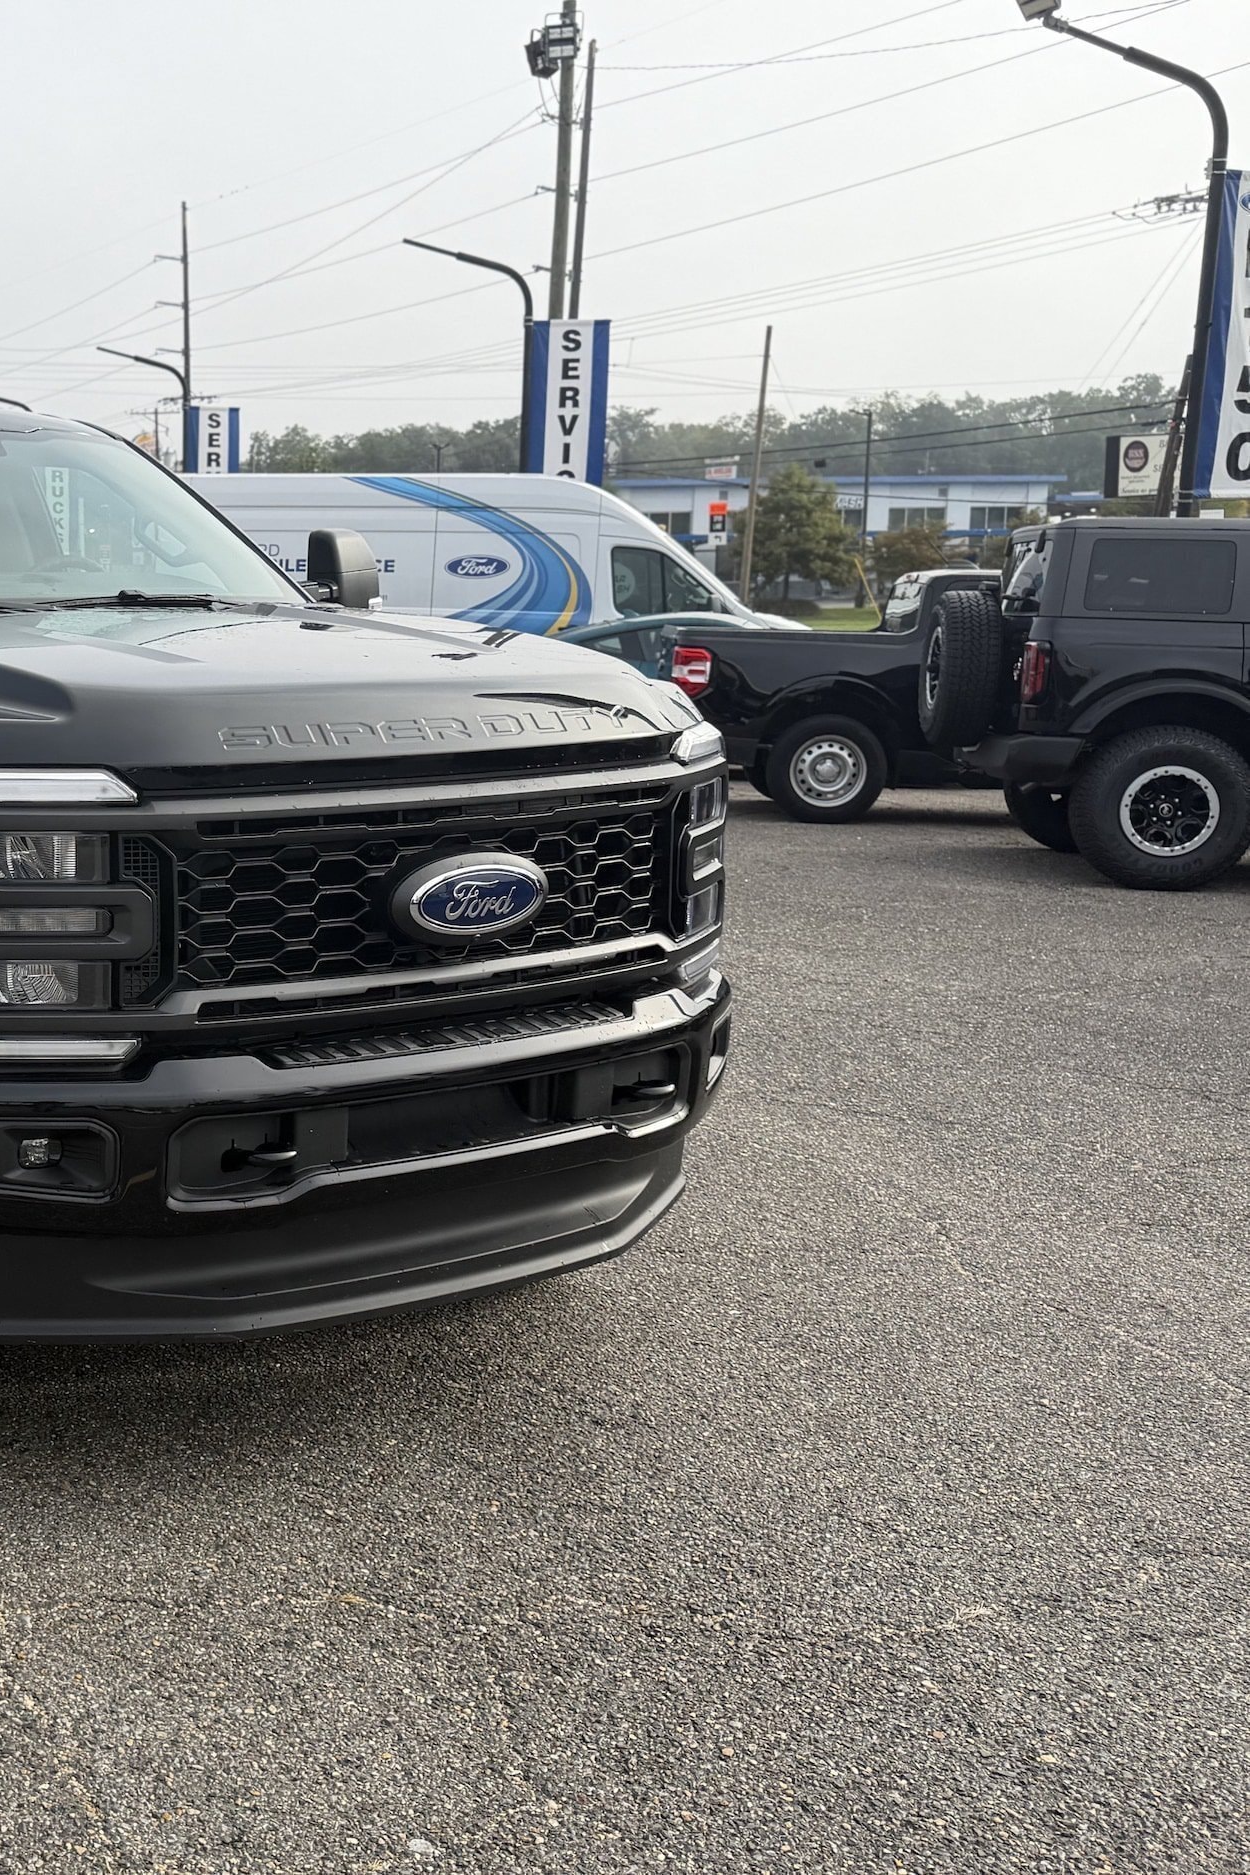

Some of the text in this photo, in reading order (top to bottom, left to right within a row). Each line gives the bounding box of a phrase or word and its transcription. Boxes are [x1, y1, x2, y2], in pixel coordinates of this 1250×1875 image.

[206, 412, 222, 474] SER
[217, 704, 627, 752] SUPER DUTY
[444, 879, 518, 921] Ford
